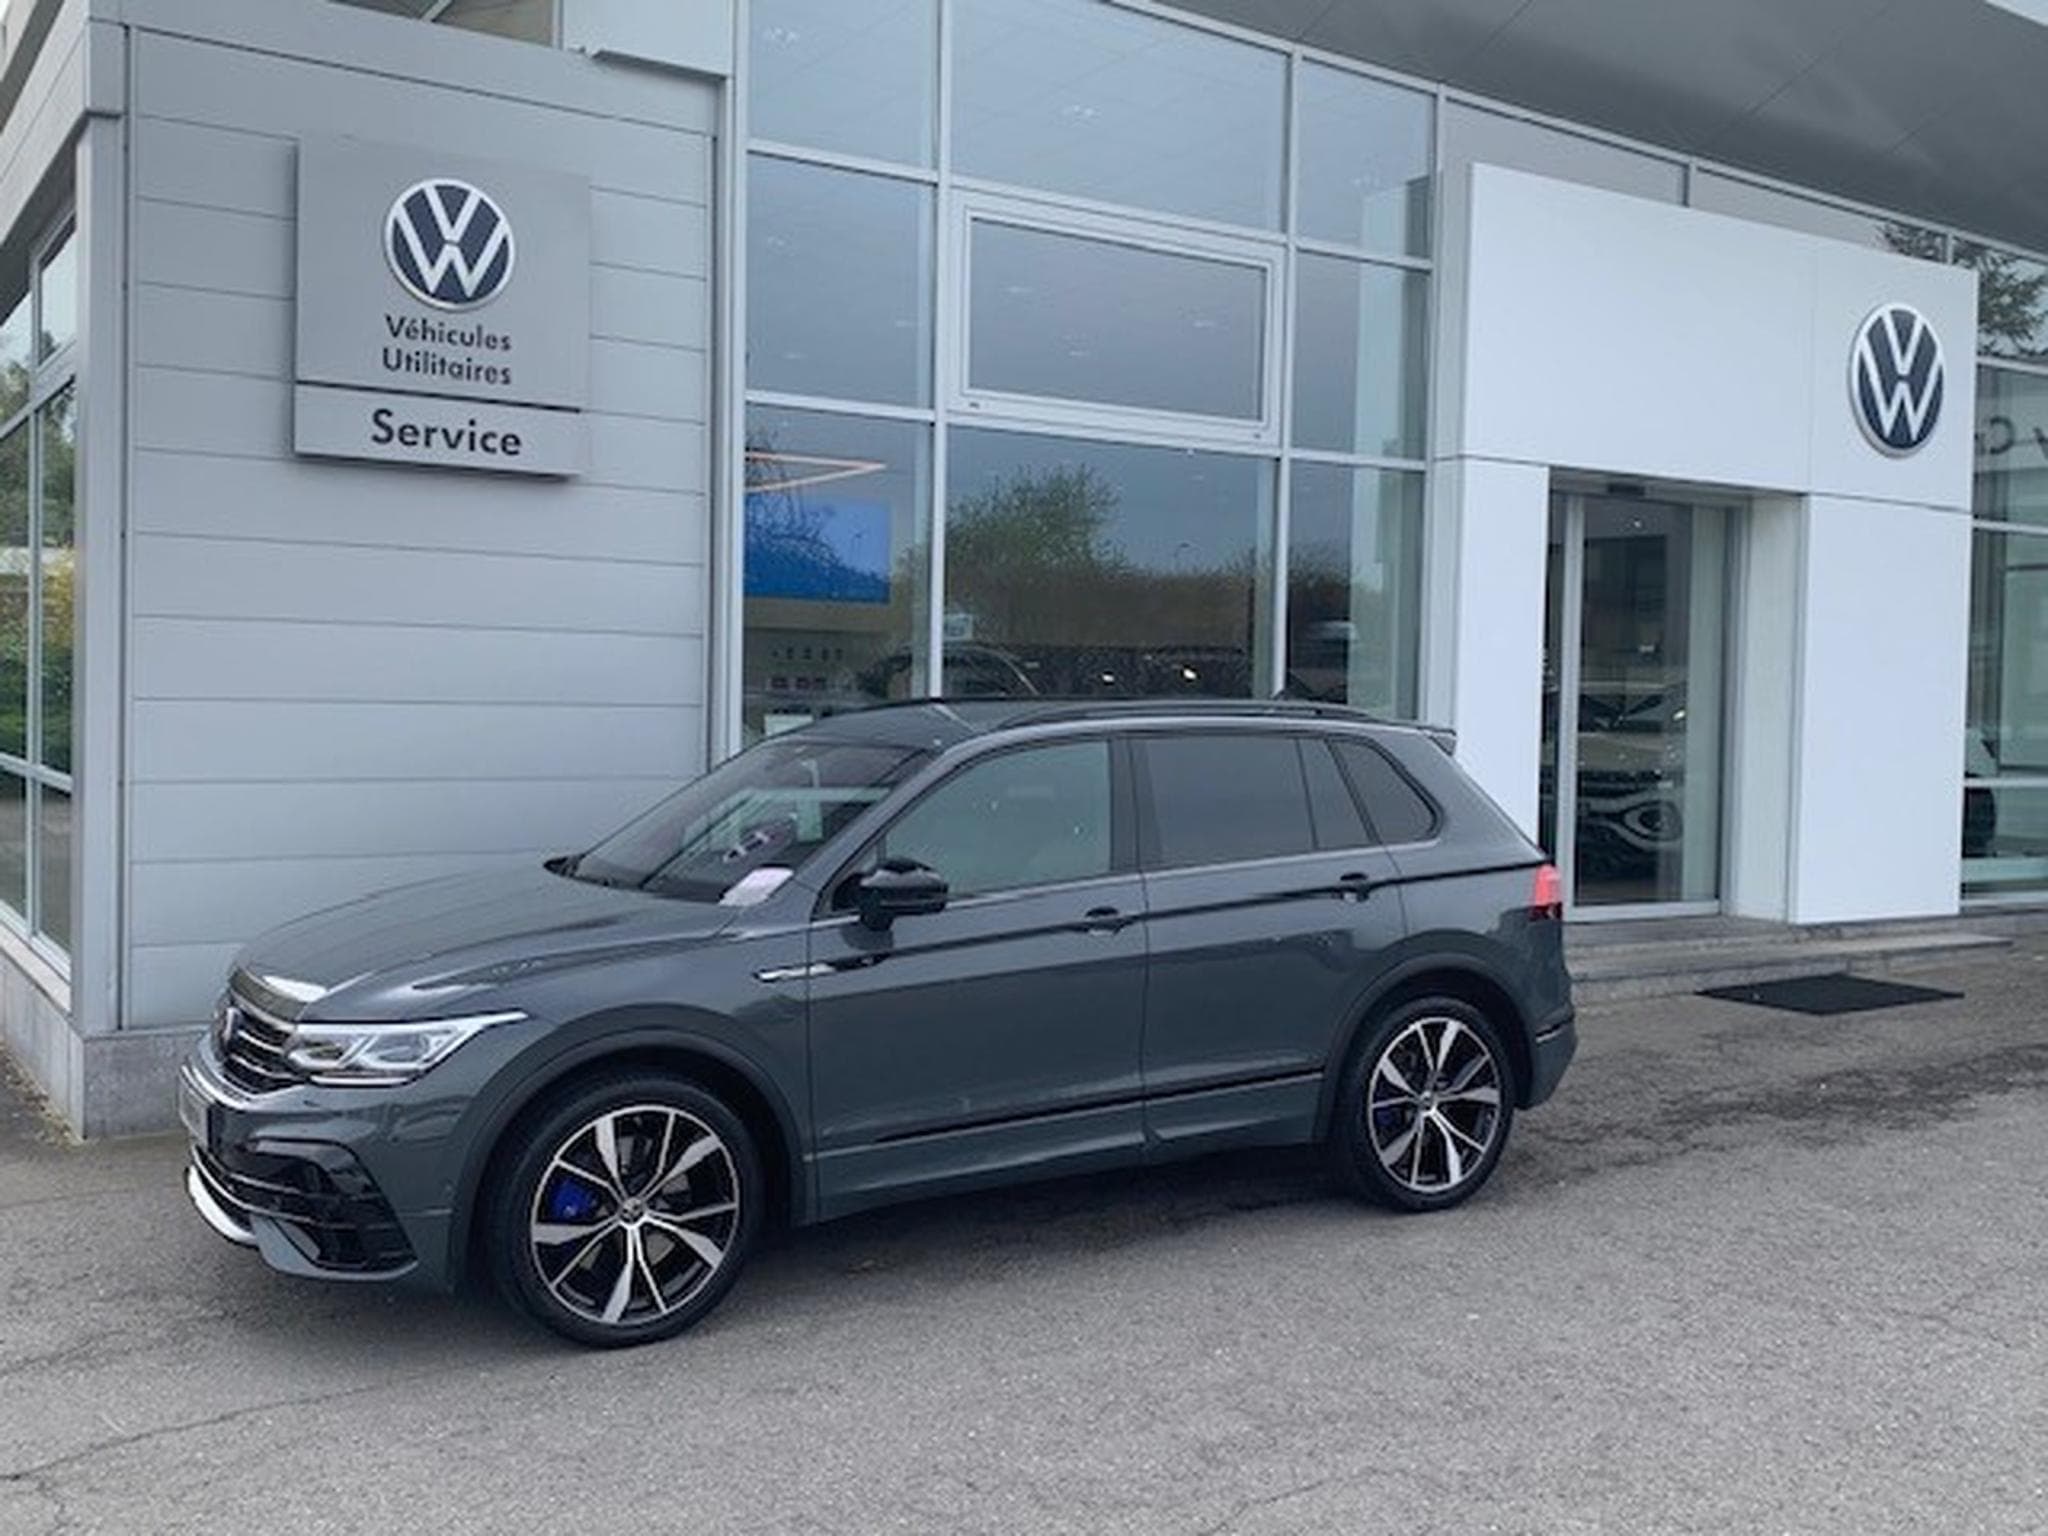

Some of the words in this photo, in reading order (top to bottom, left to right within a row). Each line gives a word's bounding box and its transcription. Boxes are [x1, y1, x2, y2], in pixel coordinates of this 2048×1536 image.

[387, 180, 514, 308] VW
[385, 313, 511, 351] Véhicules
[383, 347, 511, 385] Utilitaires
[1853, 305, 1943, 452] VW
[371, 408, 522, 456] Service
